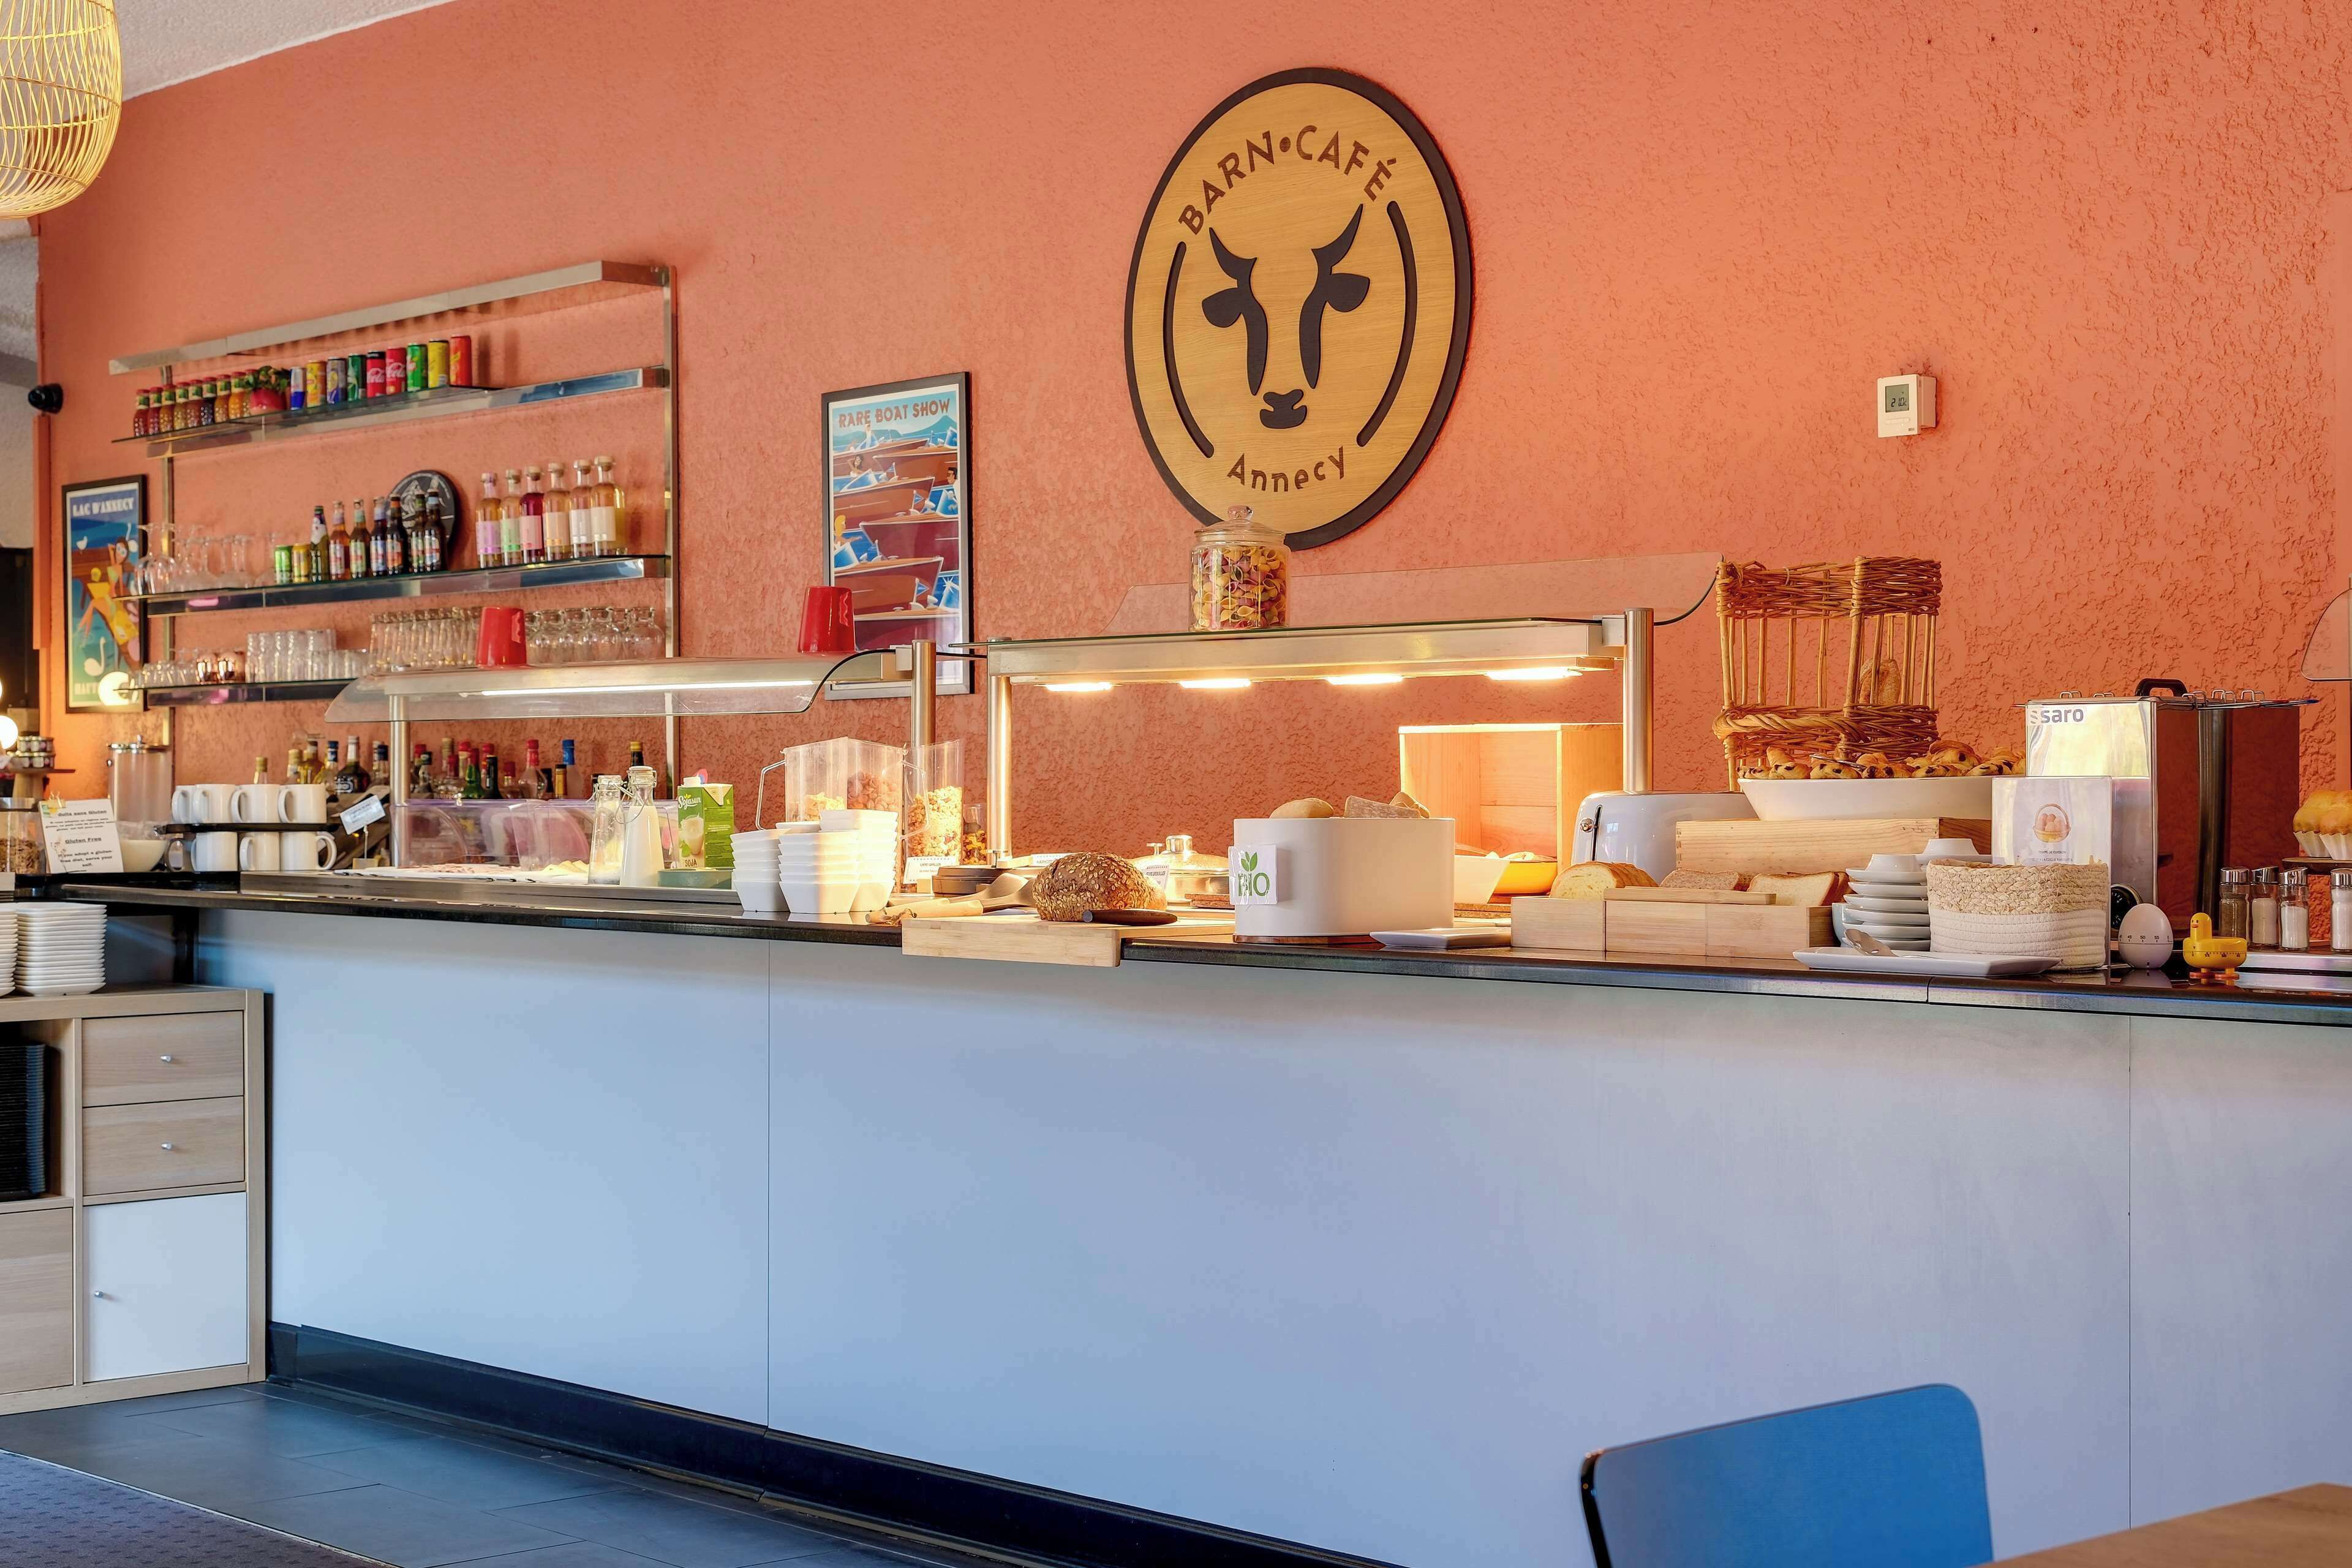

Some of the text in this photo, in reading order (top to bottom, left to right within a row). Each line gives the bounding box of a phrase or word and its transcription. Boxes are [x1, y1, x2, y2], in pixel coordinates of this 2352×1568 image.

[839, 398, 950, 428] RARE BOAT SHOW
[1226, 446, 1344, 492] Annecy
[73, 497, 134, 517] LAC D'ANNECY
[2040, 709, 2084, 723] saro
[678, 795, 701, 810] Sojasun
[1238, 872, 1270, 897] BIO
